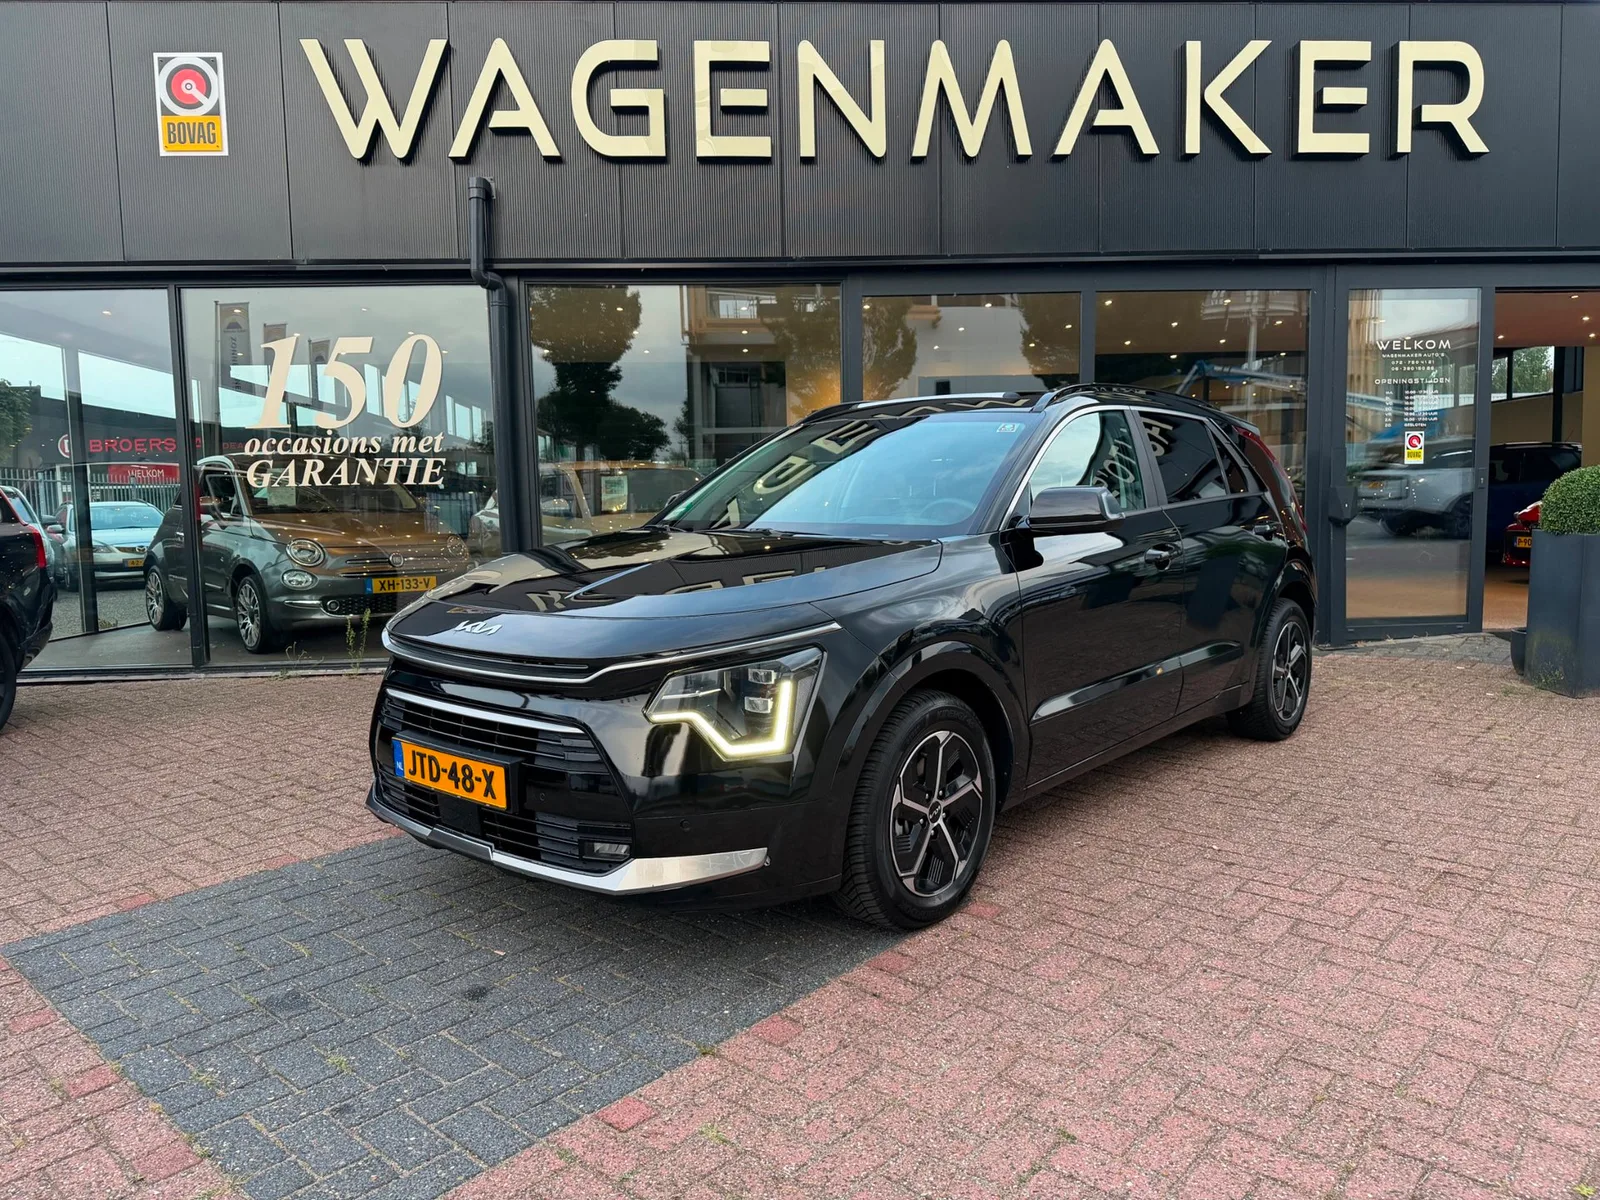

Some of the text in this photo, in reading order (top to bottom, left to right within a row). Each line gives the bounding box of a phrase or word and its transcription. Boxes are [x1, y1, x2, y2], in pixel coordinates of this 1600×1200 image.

[300, 38, 1490, 160] WAGENMAKER
[166, 121, 216, 144] BOVAG
[1376, 339, 1451, 350] WELKOM
[245, 333, 442, 430] 150
[244, 429, 445, 456] occasions met
[246, 457, 447, 488] GARANTIE
[379, 578, 431, 591] XH-133-V
[409, 750, 496, 799] JTD-48-X
